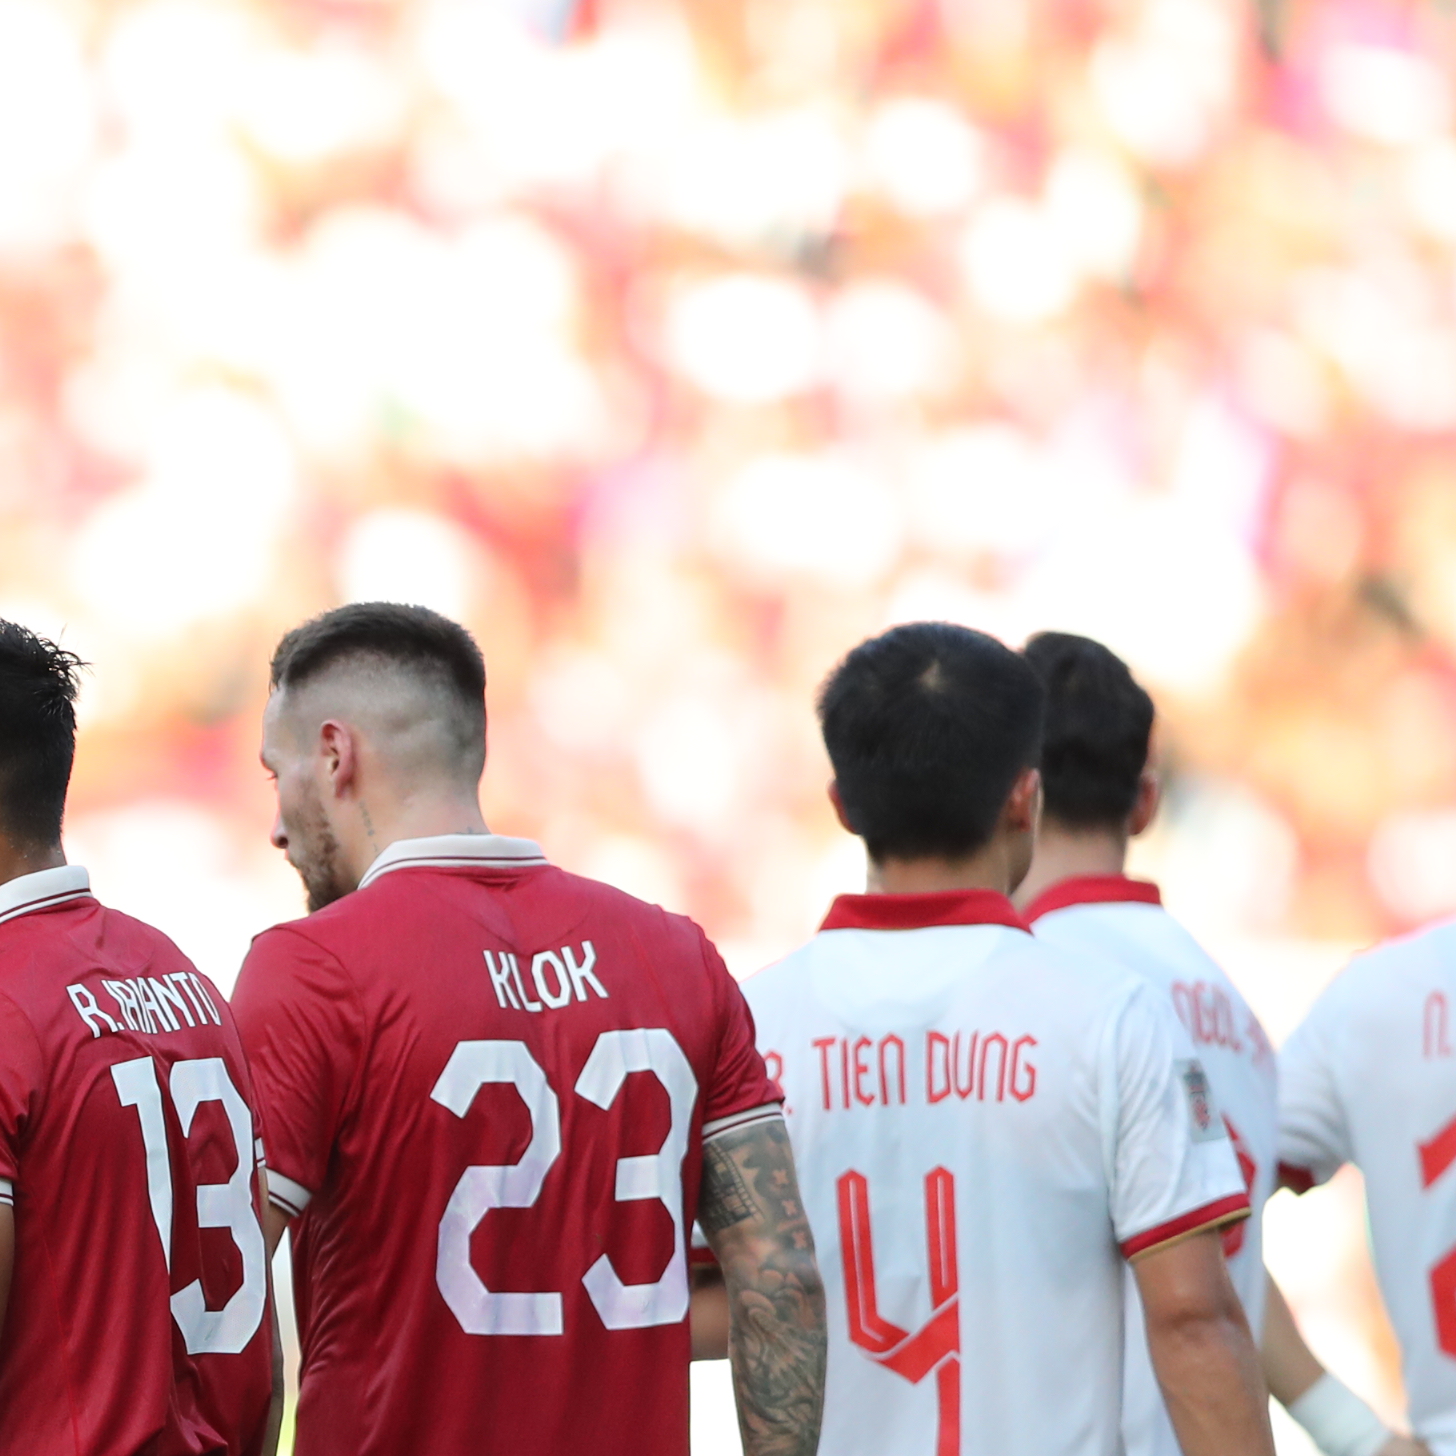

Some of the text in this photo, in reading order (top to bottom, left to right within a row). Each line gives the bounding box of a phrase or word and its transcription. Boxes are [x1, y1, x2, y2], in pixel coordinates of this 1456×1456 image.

[483, 940, 609, 1013] KLOK
[811, 1033, 908, 1112] TIEN
[925, 1030, 1038, 1106] DUNG
[110, 1055, 267, 1355] 13
[429, 1028, 699, 1336] 23
